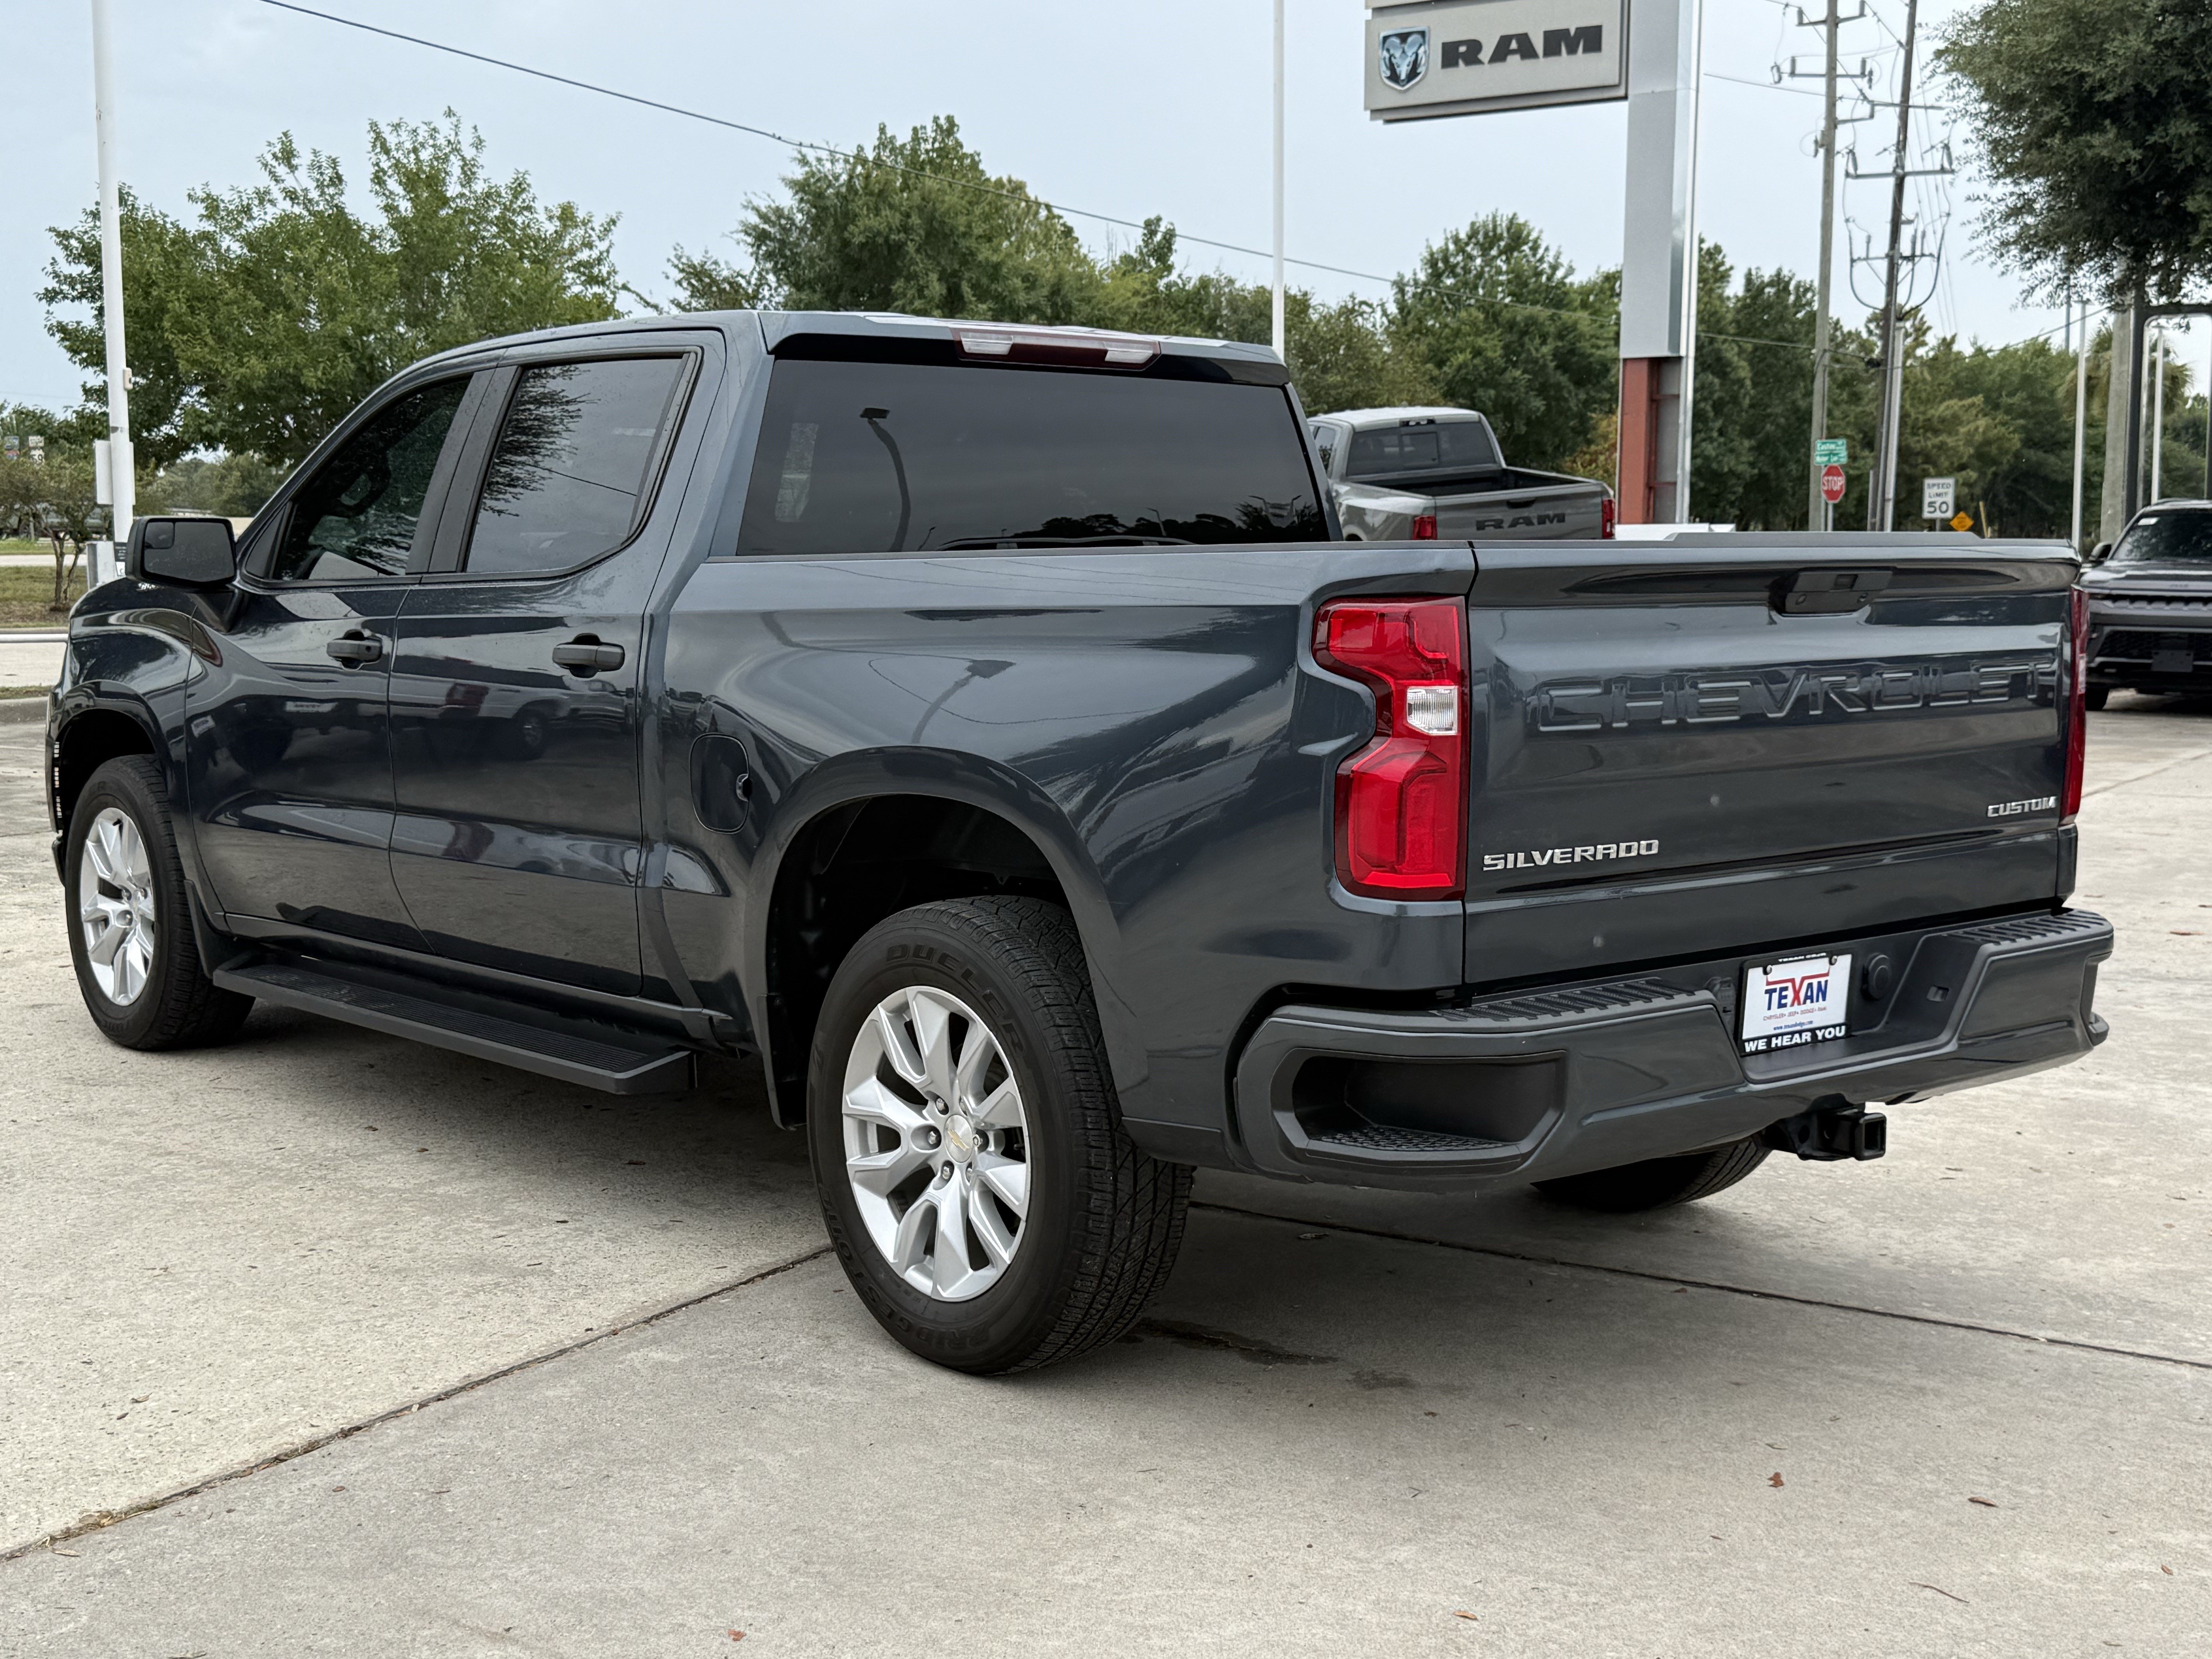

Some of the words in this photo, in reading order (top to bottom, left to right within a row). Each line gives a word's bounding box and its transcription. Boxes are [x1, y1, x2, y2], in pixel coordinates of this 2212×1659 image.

[1441, 24, 1602, 70] RAM
[1822, 476, 1844, 491] STOP
[1476, 512, 1566, 531] RAM
[1927, 501, 1949, 514] 50
[1537, 659, 2058, 732] CHEVROLET
[1987, 796, 2057, 817] CUSTOM
[1483, 840, 1659, 871] SILVERADO
[886, 943, 1024, 1054] DUELER
[1764, 973, 1829, 1010] TEXAN
[1744, 1040, 1767, 1053] WE
[1771, 1031, 1811, 1048] HEAR
[1815, 1025, 1845, 1041] YOU
